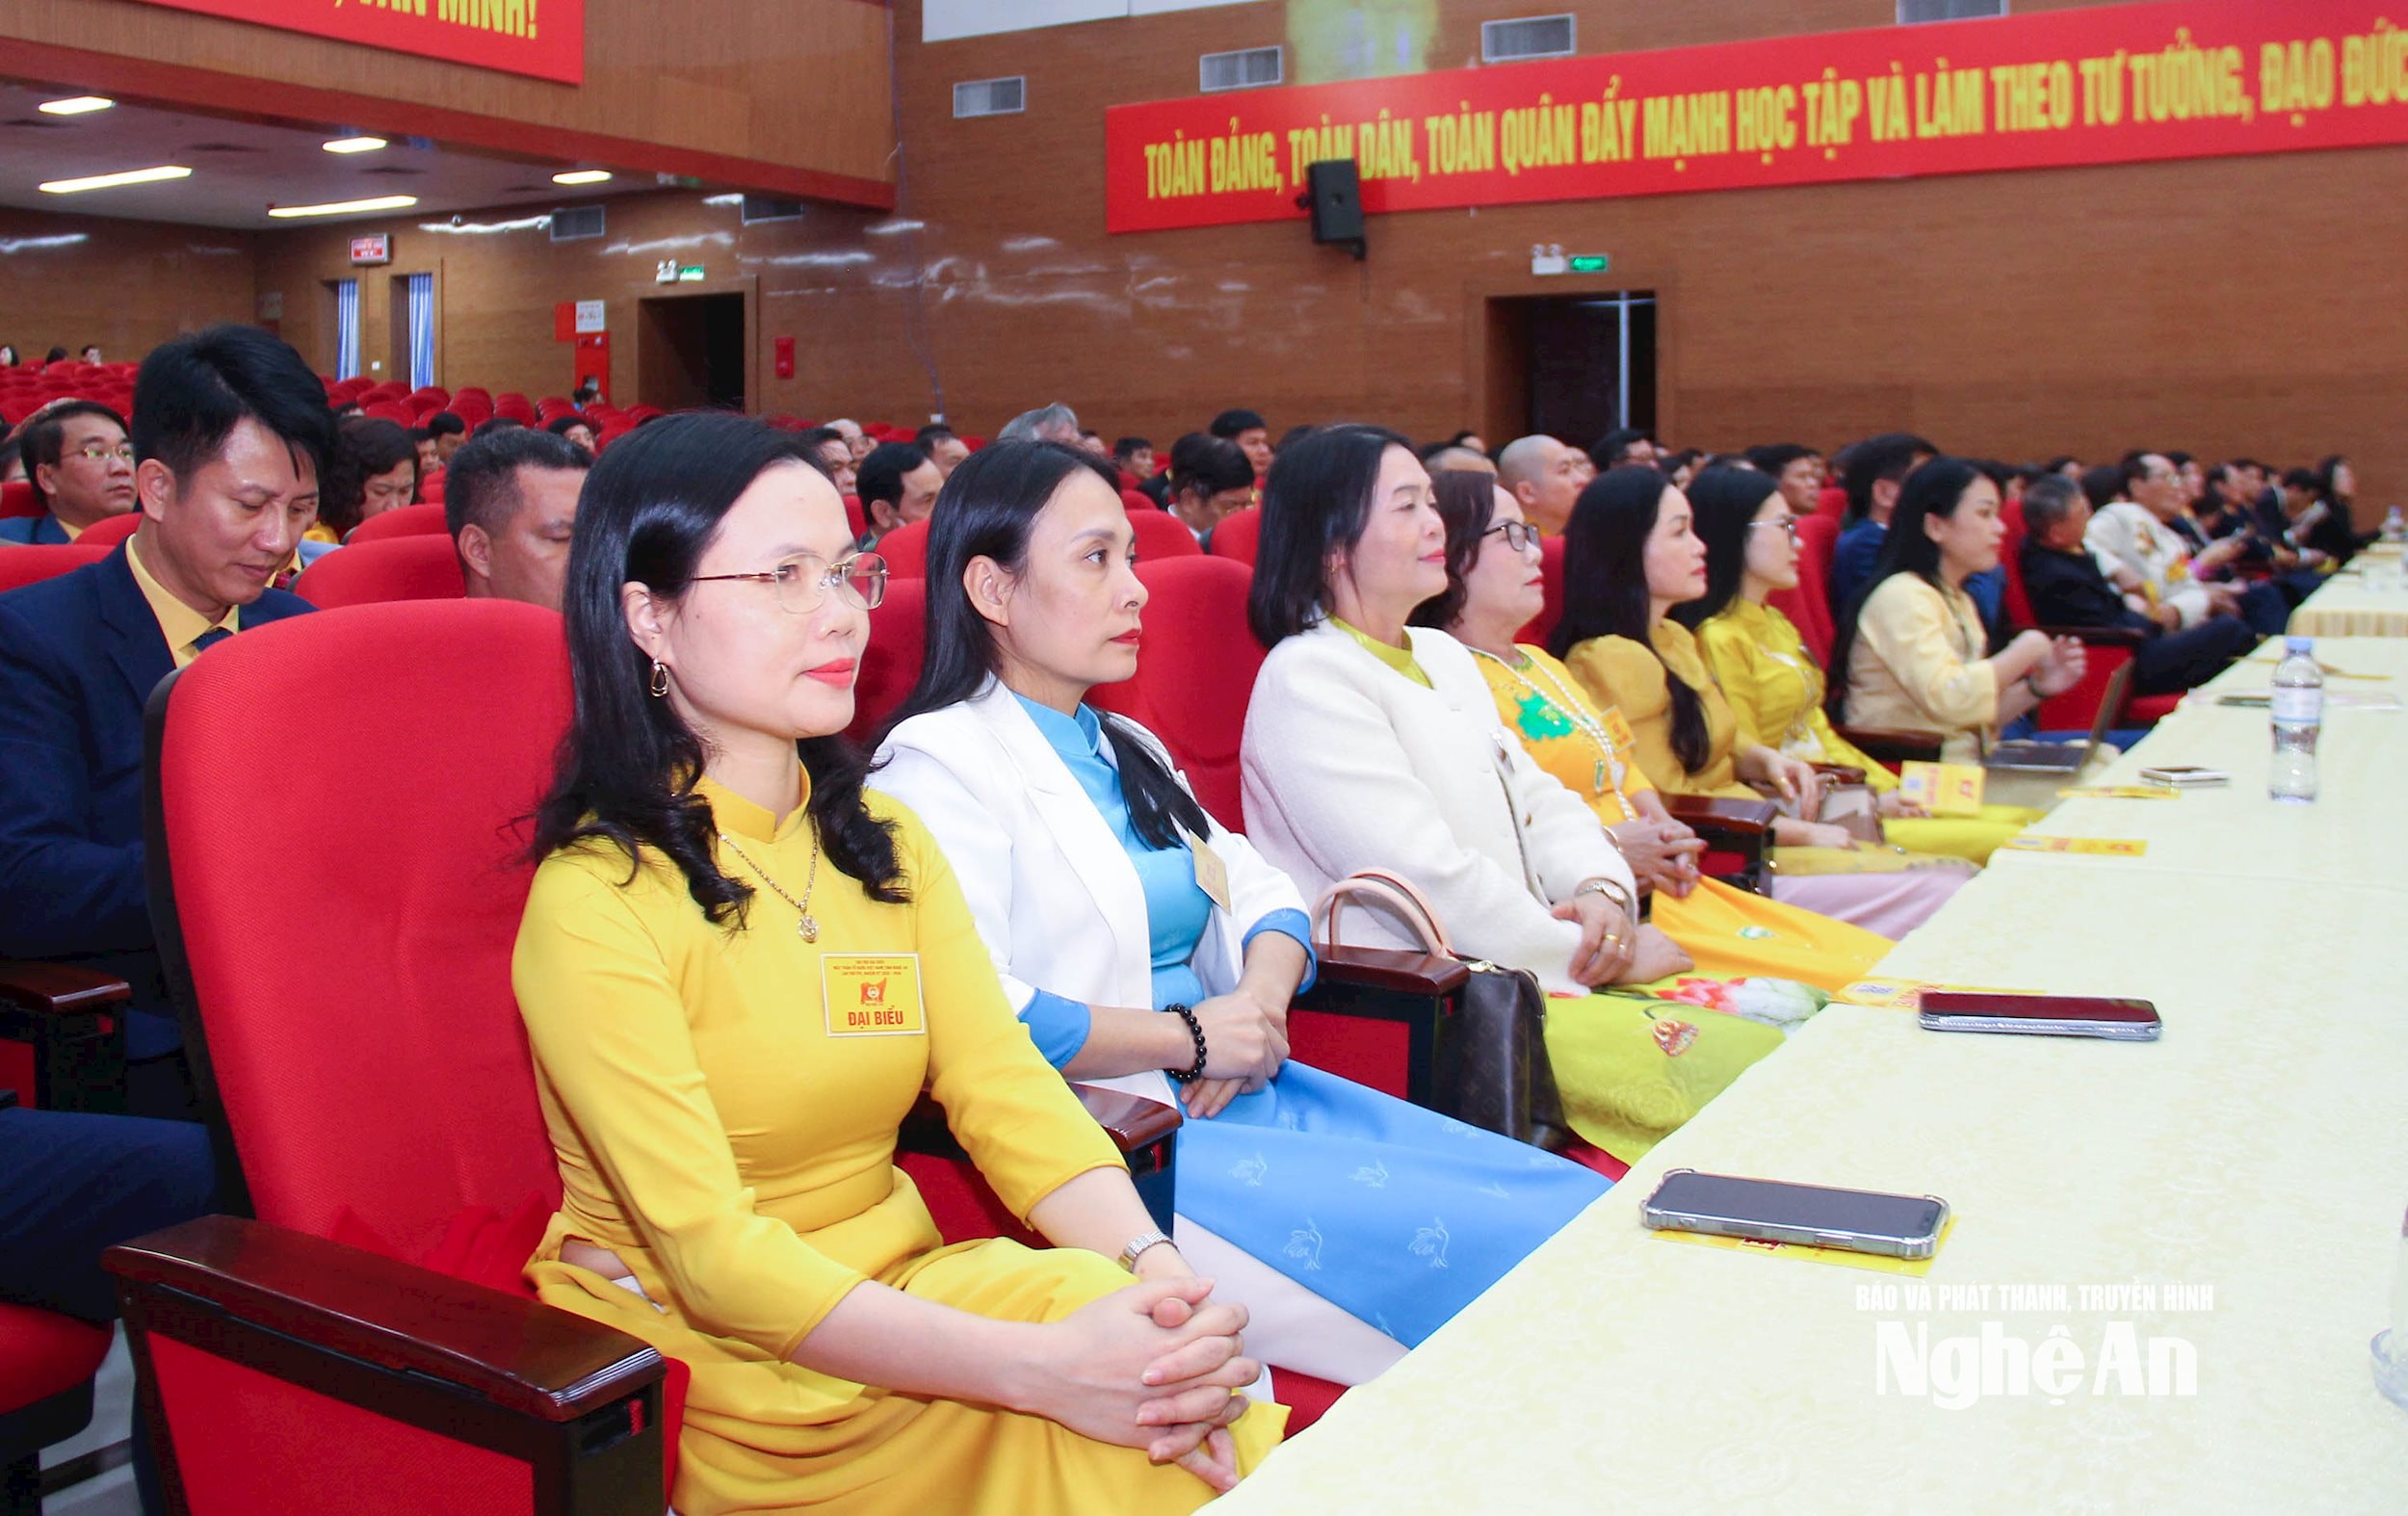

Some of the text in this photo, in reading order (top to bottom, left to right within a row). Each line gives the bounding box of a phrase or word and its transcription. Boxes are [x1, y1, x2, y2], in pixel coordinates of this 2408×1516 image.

[1145, 129, 1204, 199] TOÀN
[1210, 116, 1282, 195] ĐẢNG,
[1358, 108, 1420, 183] DÂN,
[1426, 100, 1495, 174] TOÀN
[1501, 93, 1576, 175] QUÂN
[1582, 74, 1637, 164] ĐẨY
[1643, 90, 1730, 172] MẠNH
[1737, 84, 1797, 166] HỌC
[1802, 66, 1862, 160] TẬP
[1866, 61, 1910, 142] VÀ
[1916, 57, 1984, 138] LÀM
[1990, 60, 2073, 133] THEO
[2079, 49, 2126, 125] TƯ
[2130, 27, 2255, 124] TƯỞNG,
[2260, 39, 2334, 127] ĐẠO
[848, 1005, 904, 1029] ĐẠI BIỂU
